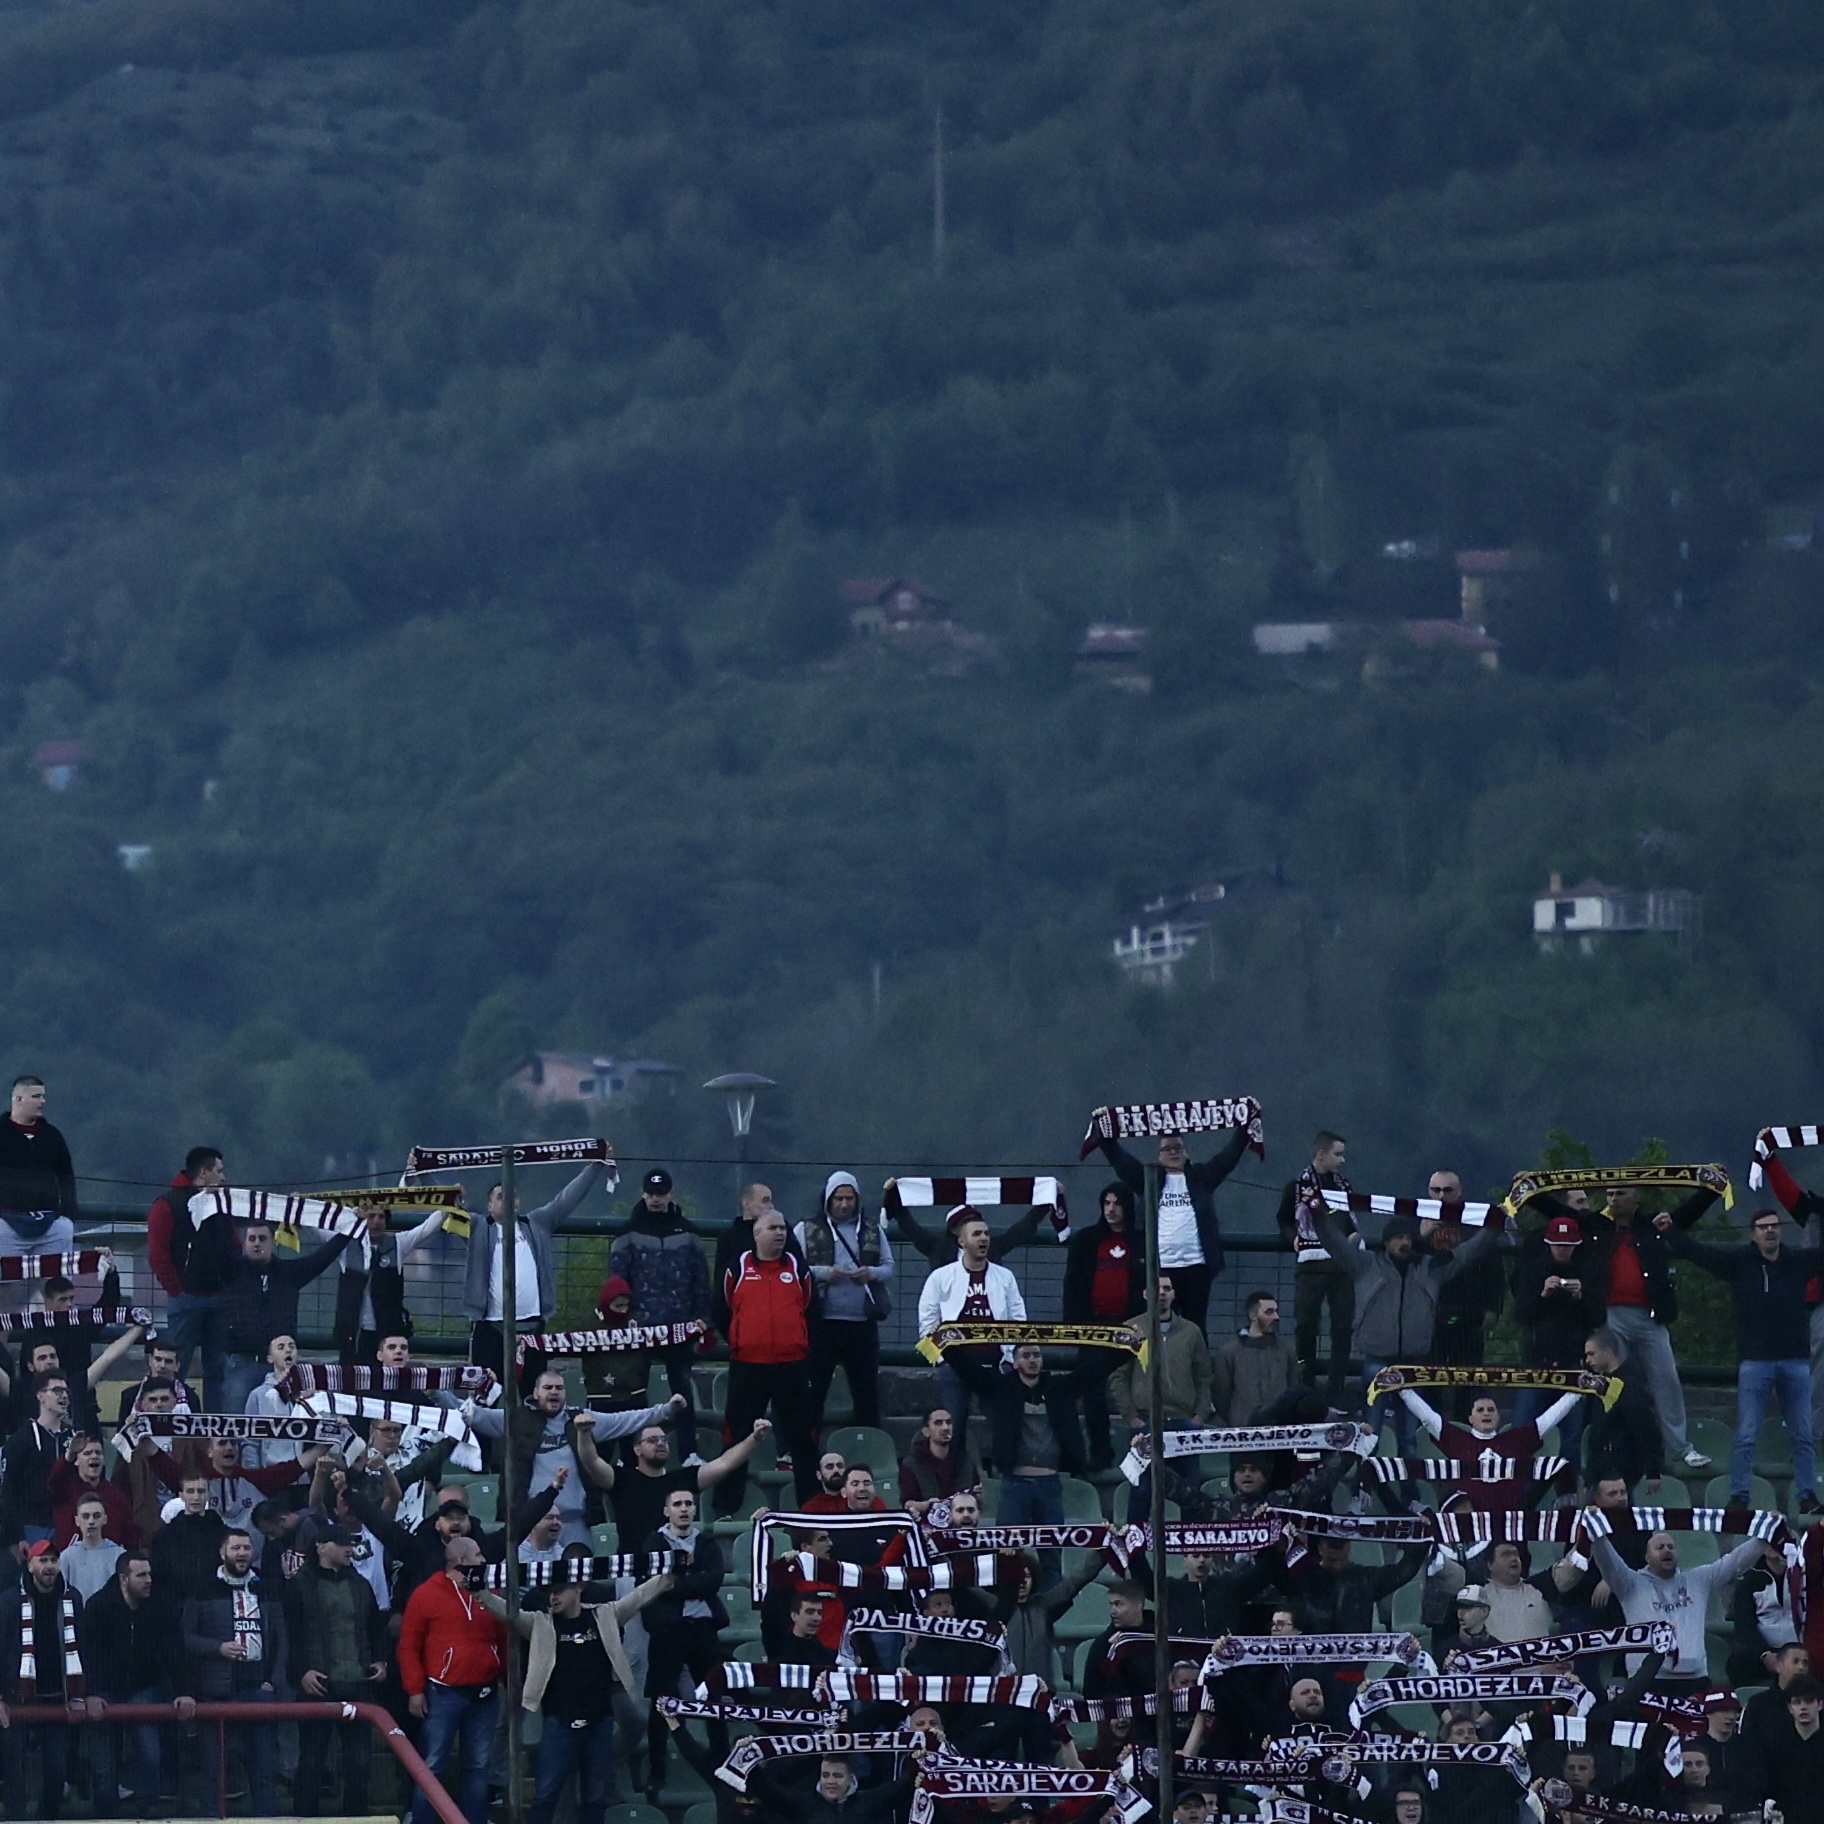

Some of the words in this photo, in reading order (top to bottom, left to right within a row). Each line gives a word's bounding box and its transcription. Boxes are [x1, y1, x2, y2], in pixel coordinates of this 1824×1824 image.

[1150, 1101, 1248, 1129] SARAJEVO
[535, 1139, 599, 1154] HORDE
[575, 1328, 669, 1347] SARAJEVO
[969, 1325, 1111, 1343] SARAJEVO
[1415, 1368, 1566, 1385] SARAJEVO
[172, 1415, 307, 1439] SARAJEVO
[1209, 1426, 1313, 1445] SARAJEVO
[958, 1526, 1093, 1549] SARAJEVO
[1187, 1527, 1269, 1545] SARAJEVO
[1473, 1625, 1650, 1671] SARAJEVO
[1397, 1677, 1545, 1698] HORDEZLA
[679, 1700, 821, 1722] SARAJEVO
[1345, 1741, 1497, 1764] SARAJEVO
[1214, 1759, 1308, 1777] SARAJEVO
[945, 1771, 1095, 1793] SARAJEVO
